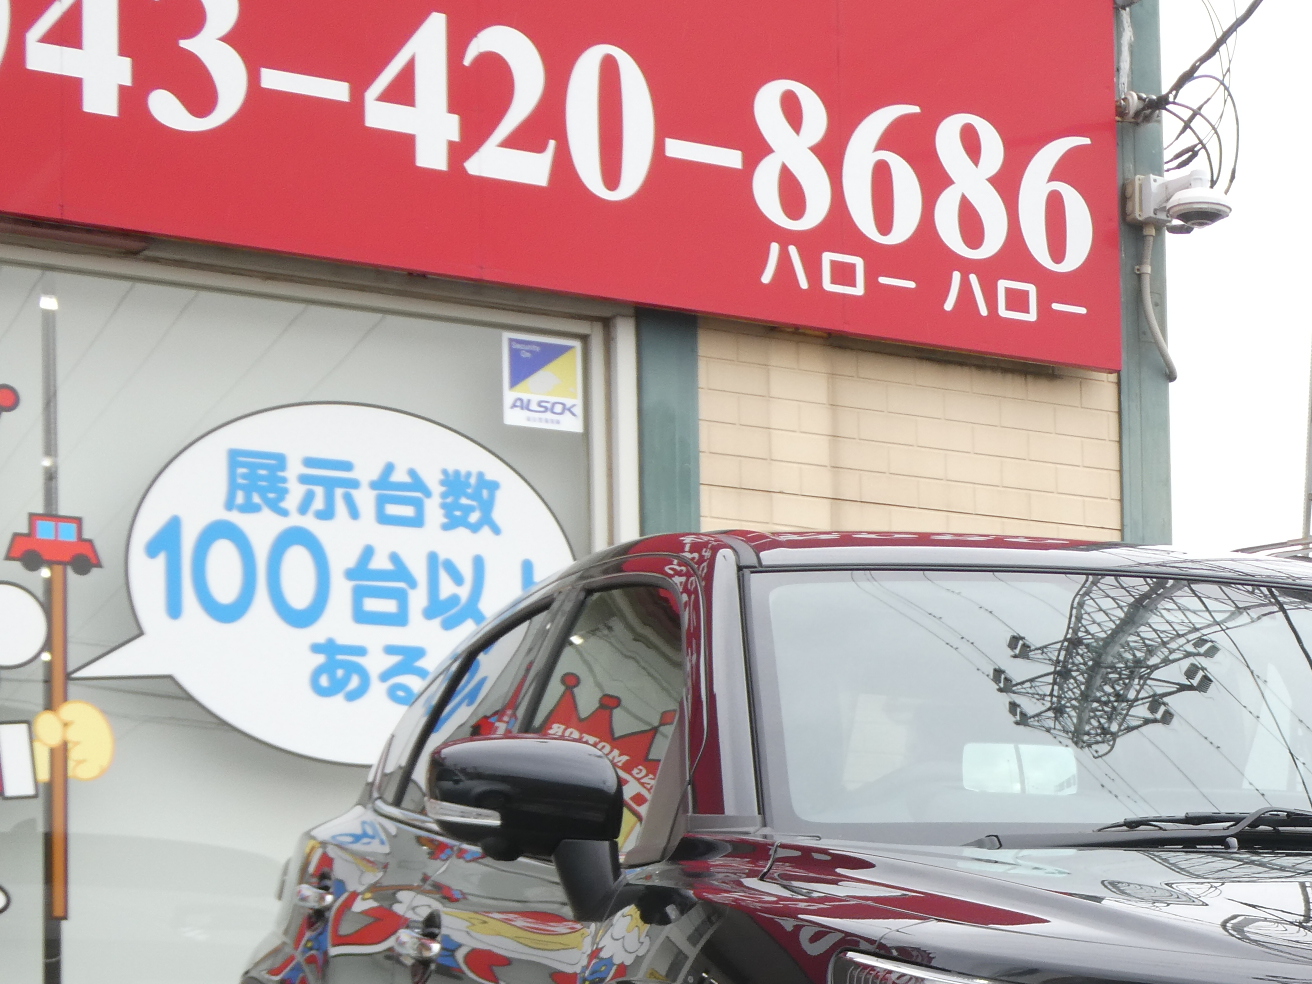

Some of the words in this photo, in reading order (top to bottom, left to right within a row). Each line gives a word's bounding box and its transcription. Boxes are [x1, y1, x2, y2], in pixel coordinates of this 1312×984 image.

[0, 0, 1093, 273] 43-420-8686
[760, 242, 917, 296] ハロー
[943, 270, 1088, 322] ハロー
[510, 396, 578, 418] ALSOK
[223, 447, 502, 537] 展示台数
